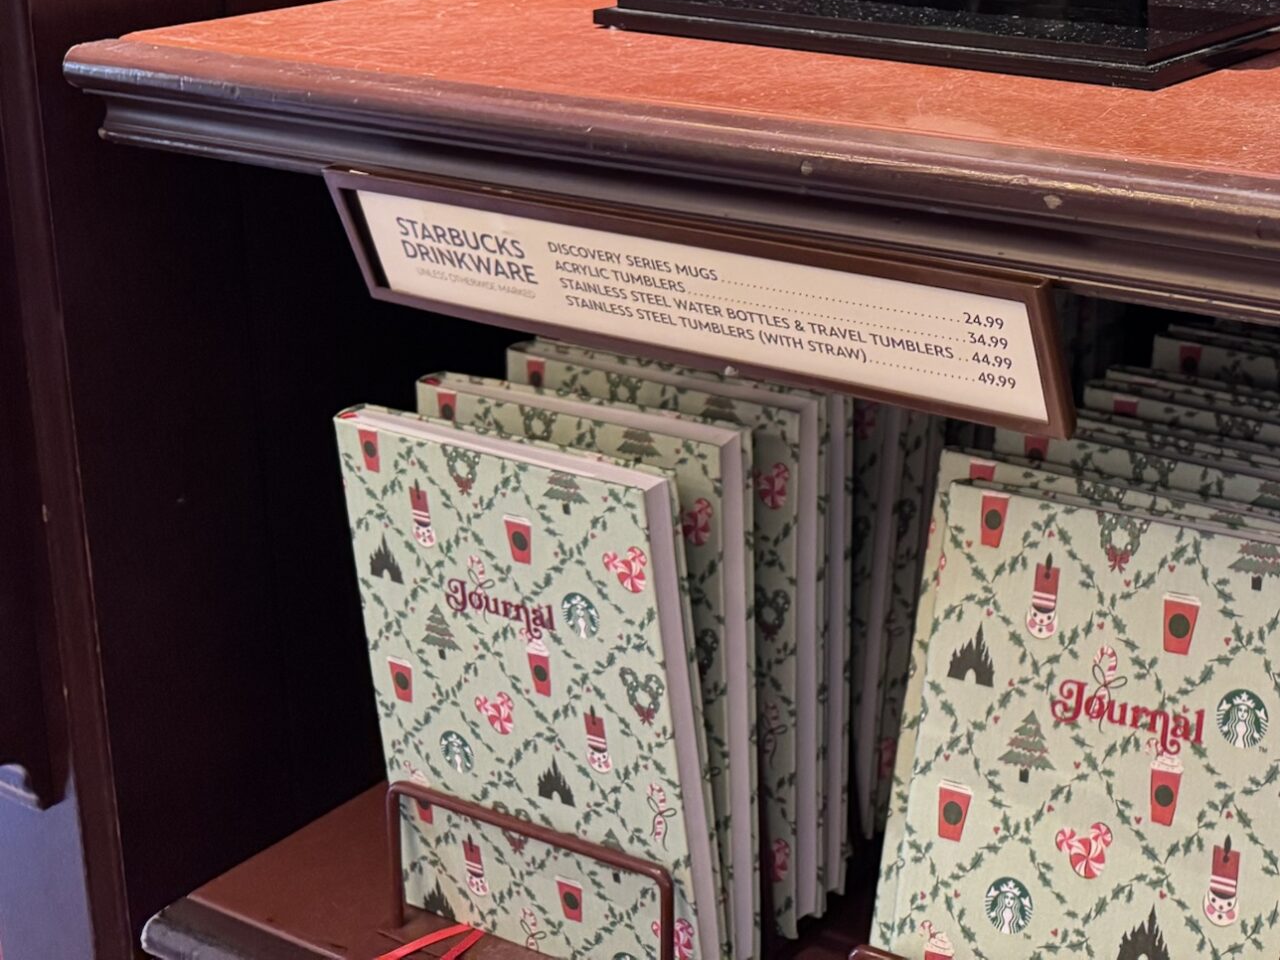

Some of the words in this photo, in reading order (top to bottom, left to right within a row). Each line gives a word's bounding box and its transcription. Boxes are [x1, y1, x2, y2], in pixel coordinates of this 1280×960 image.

[396, 216, 525, 259] STARBUCKS
[401, 239, 539, 285] DRINKWARE
[547, 241, 621, 265] DISCOVERY
[626, 255, 672, 273] SERIES
[675, 263, 718, 281] MUGS
[963, 312, 1004, 330] 24.99
[555, 260, 610, 280] ACRYLIC
[611, 269, 686, 293] TUMBLERS
[968, 332, 1008, 350] 34.99
[560, 277, 628, 300] STAINLESS
[631, 290, 672, 308] STEEL
[673, 297, 723, 318] WATER
[727, 308, 790, 330] BOTTLES
[794, 320, 805, 332] &
[808, 322, 867, 344] TRAVEL
[869, 333, 955, 360] TUMBLERS
[972, 352, 1012, 370] 44.99
[565, 295, 633, 318] STAINLESS
[636, 308, 677, 326] STEEL
[678, 316, 755, 341] TUMBLERS
[758, 330, 804, 350] (WITH
[808, 340, 867, 363] STRAW)
[978, 372, 1016, 389] 49.99
[445, 578, 556, 640] Journal
[1050, 679, 1205, 756] Journal
